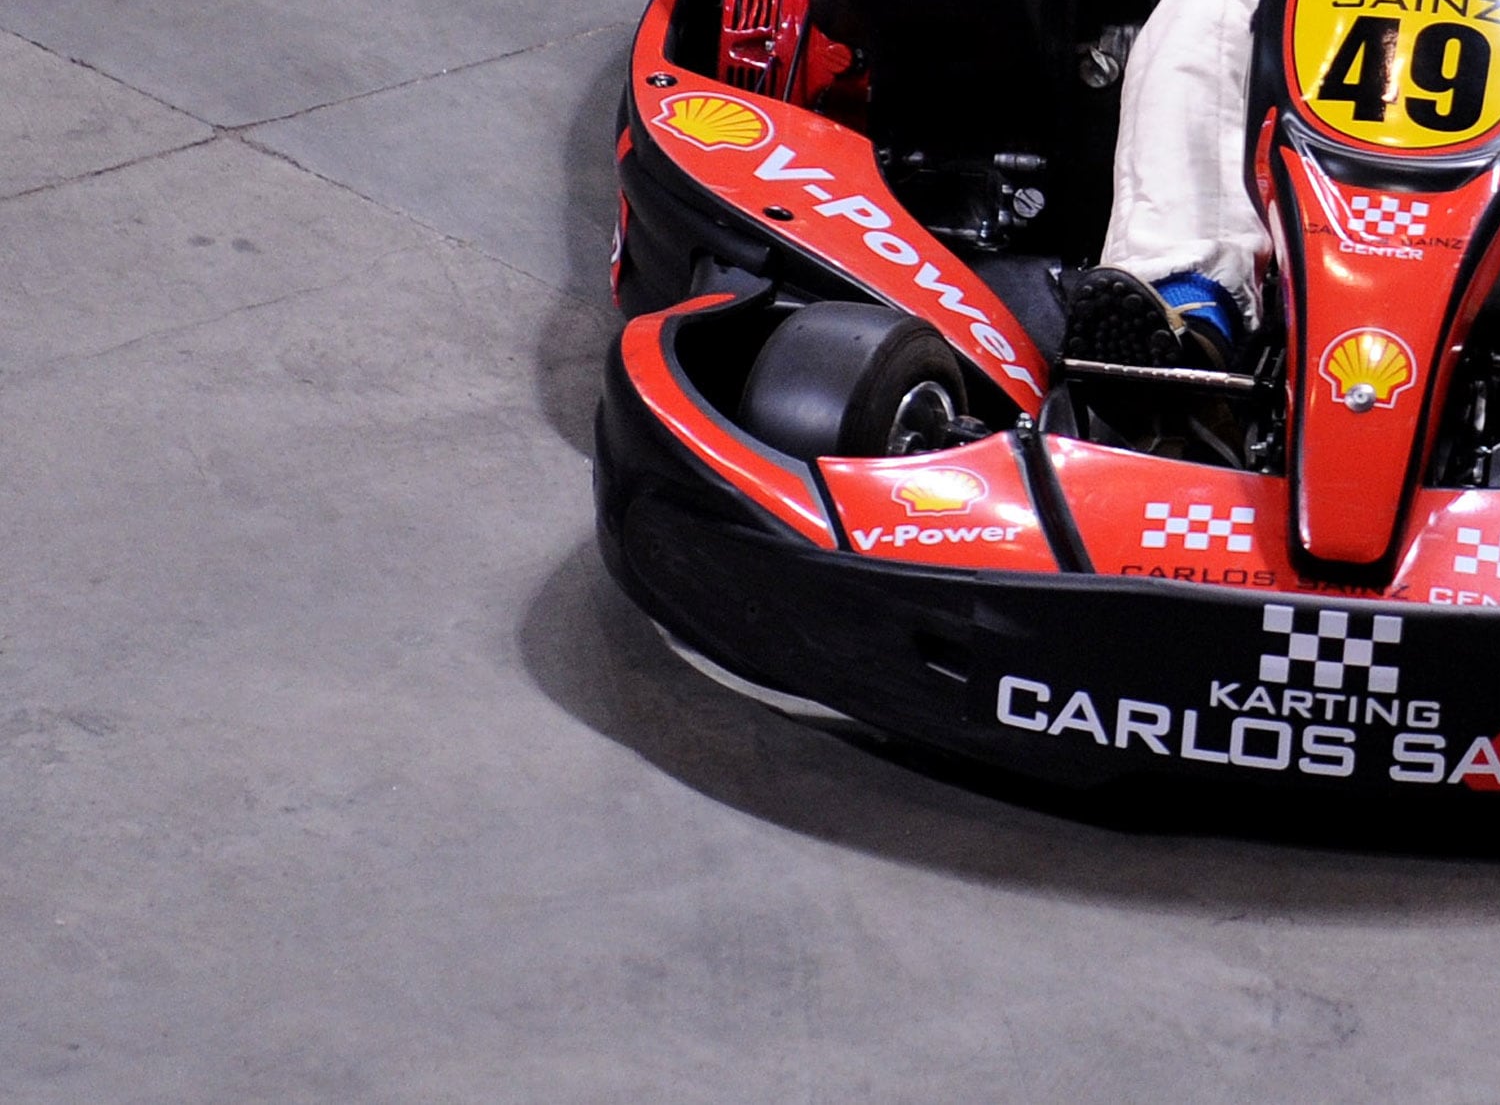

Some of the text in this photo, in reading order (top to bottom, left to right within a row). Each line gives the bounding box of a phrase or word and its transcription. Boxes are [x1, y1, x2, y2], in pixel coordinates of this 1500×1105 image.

[1317, 15, 1492, 133] 49
[753, 144, 1044, 398] V-Power
[1339, 241, 1424, 261] CENTER
[852, 525, 1023, 551] V-Power
[996, 675, 1356, 777] CARLOS
[1210, 680, 1441, 728] KARTING
